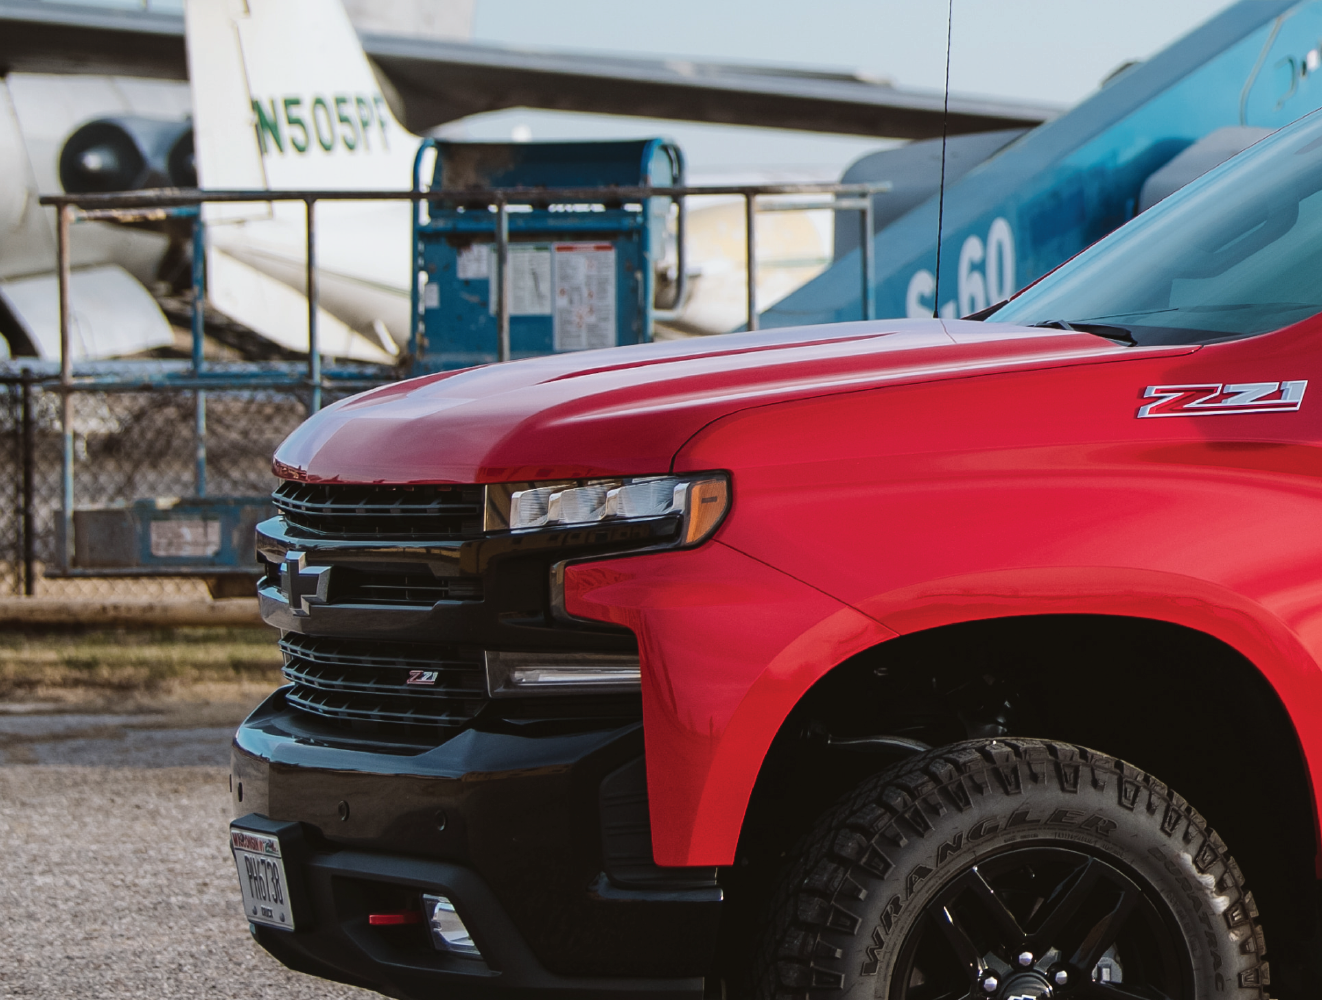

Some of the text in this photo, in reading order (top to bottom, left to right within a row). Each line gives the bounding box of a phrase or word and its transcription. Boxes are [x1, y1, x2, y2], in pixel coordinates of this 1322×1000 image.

[252, 93, 390, 154] N505PF
[1136, 380, 1308, 418] Z71
[861, 808, 1118, 976] WRANGLER
[1148, 847, 1225, 991] DURATRAC
